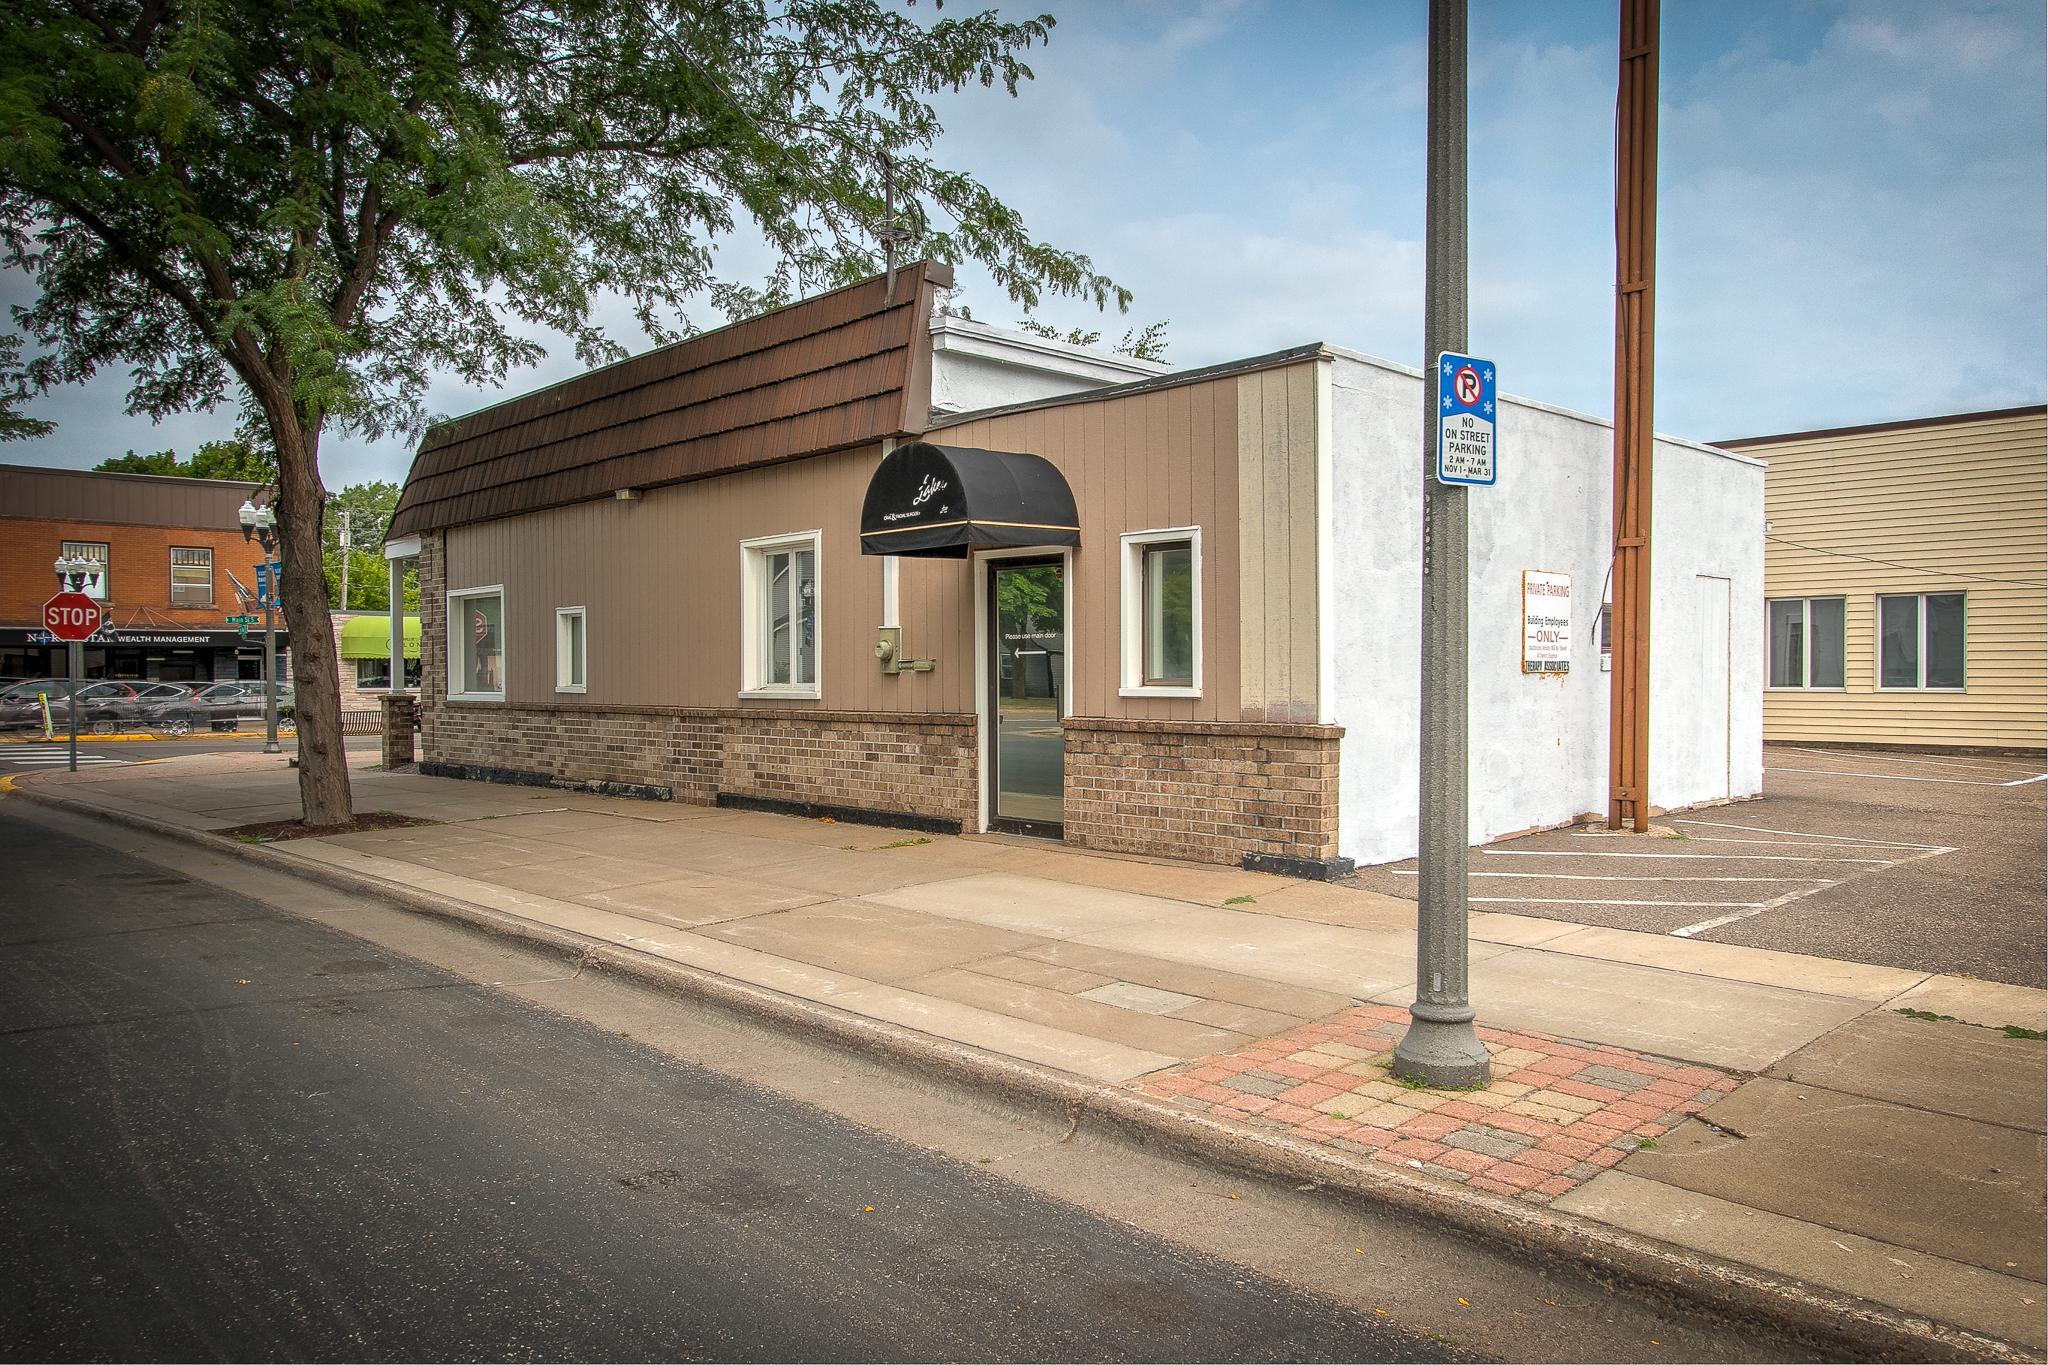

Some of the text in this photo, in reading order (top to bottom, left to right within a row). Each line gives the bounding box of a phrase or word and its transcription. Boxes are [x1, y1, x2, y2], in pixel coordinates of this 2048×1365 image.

[1462, 417, 1474, 428] NO
[1445, 428, 1490, 443] ON STREET
[1449, 442, 1486, 455] PARKING
[1449, 455, 1454, 463] 2
[1455, 456, 1465, 464] AM
[1476, 458, 1486, 466] AM
[1444, 464, 1457, 473] NOV
[1468, 467, 1482, 476] MAR
[1483, 468, 1491, 477] 31
[1527, 582, 1570, 597] PRIVATE PARKING
[48, 607, 97, 625] STOP
[1527, 615, 1569, 628] Building Employees
[1536, 630, 1560, 642] ONLY
